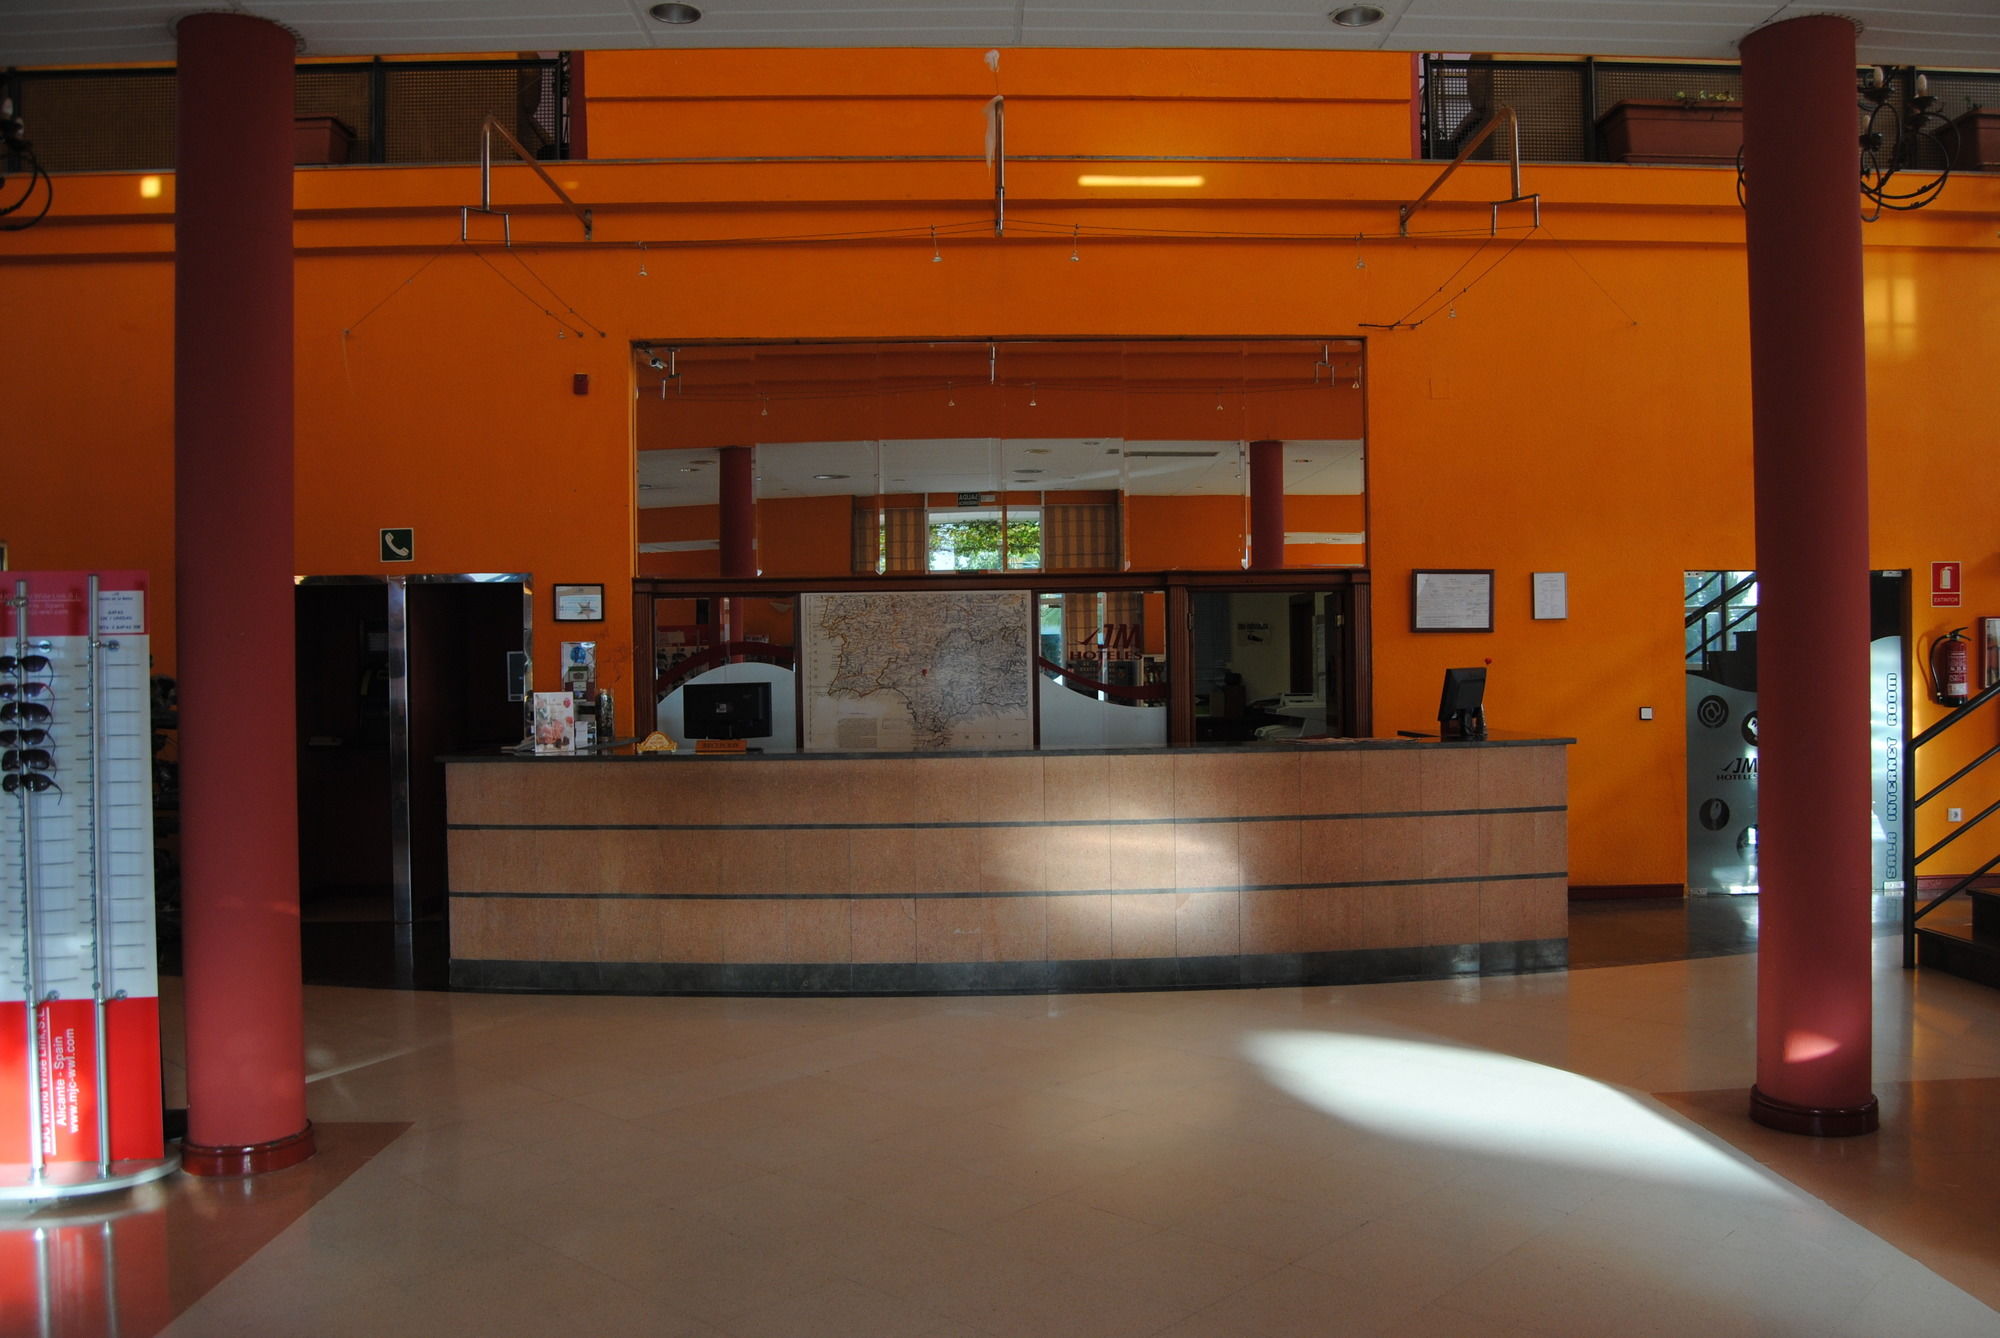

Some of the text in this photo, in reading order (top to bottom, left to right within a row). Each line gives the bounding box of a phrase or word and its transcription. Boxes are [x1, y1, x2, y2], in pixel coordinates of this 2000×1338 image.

[1070, 651, 1142, 660] HOTELES
[1886, 673, 1898, 879] SALA INTERNET ROOM
[54, 1036, 66, 1069] Spain
[55, 1079, 67, 1126] Alicante
[66, 1028, 79, 1134] www.mjc-wwl.com
